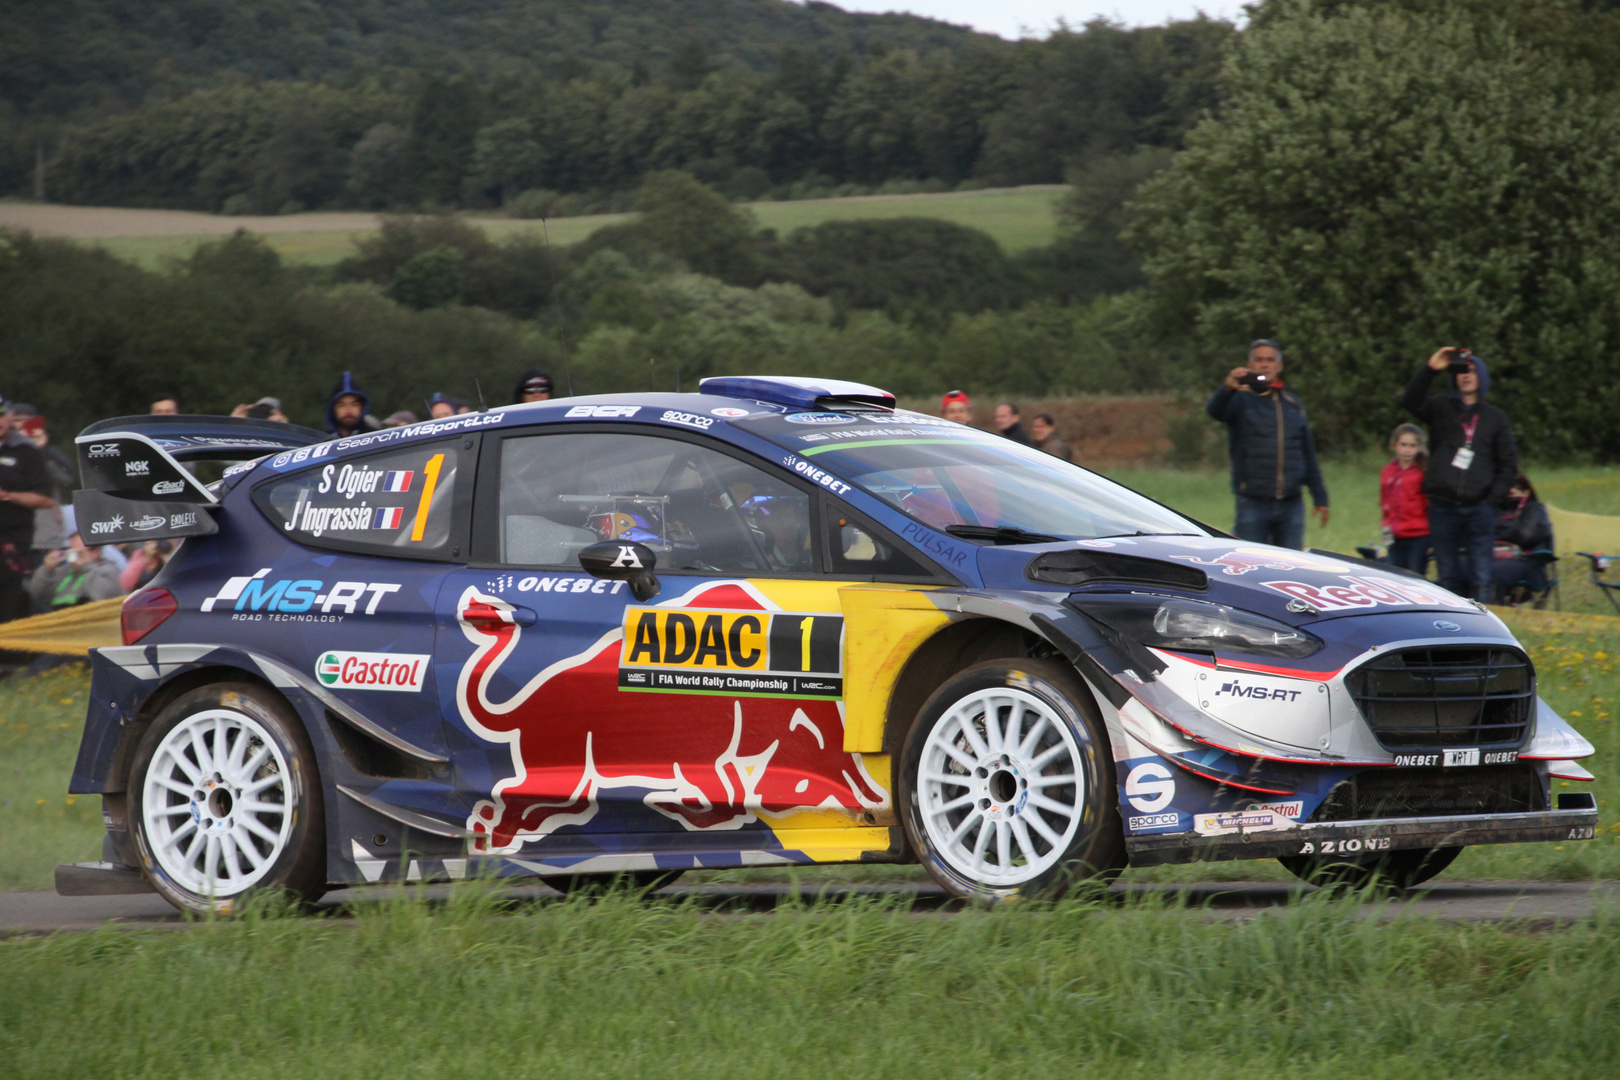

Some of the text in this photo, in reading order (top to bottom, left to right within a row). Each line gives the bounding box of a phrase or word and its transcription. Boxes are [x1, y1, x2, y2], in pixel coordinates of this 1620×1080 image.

[661, 410, 714, 427] sparco
[89, 443, 120, 453] OZ
[336, 430, 400, 451] Search
[125, 460, 149, 472] NGK
[318, 463, 384, 500] S Ogier
[795, 461, 851, 496] ONEBET
[410, 453, 446, 542] 1
[91, 521, 118, 534] SWP
[170, 512, 196, 526] ENDLESS
[284, 500, 373, 538] J Ingrassia
[902, 522, 967, 568] PULSAR
[609, 545, 644, 568] A
[517, 577, 628, 594] ONEBET
[1260, 575, 1413, 612] Red
[233, 579, 402, 615] MS-RT
[231, 613, 344, 623] ROAD TECHNOLOGY
[628, 611, 762, 669] ADAC
[799, 616, 815, 672] 1
[342, 655, 421, 687] Castrol
[627, 673, 646, 682] WRC
[658, 673, 788, 690] FIA World Rally Championship
[801, 681, 837, 690] WRC.com
[1231, 683, 1302, 702] MS-RT
[1395, 755, 1439, 766] ONEBET
[1484, 751, 1519, 764] ONEBET
[1130, 813, 1178, 830] sparco
[1221, 815, 1272, 827] MICHELIN
[1299, 836, 1392, 855] AZIONE
